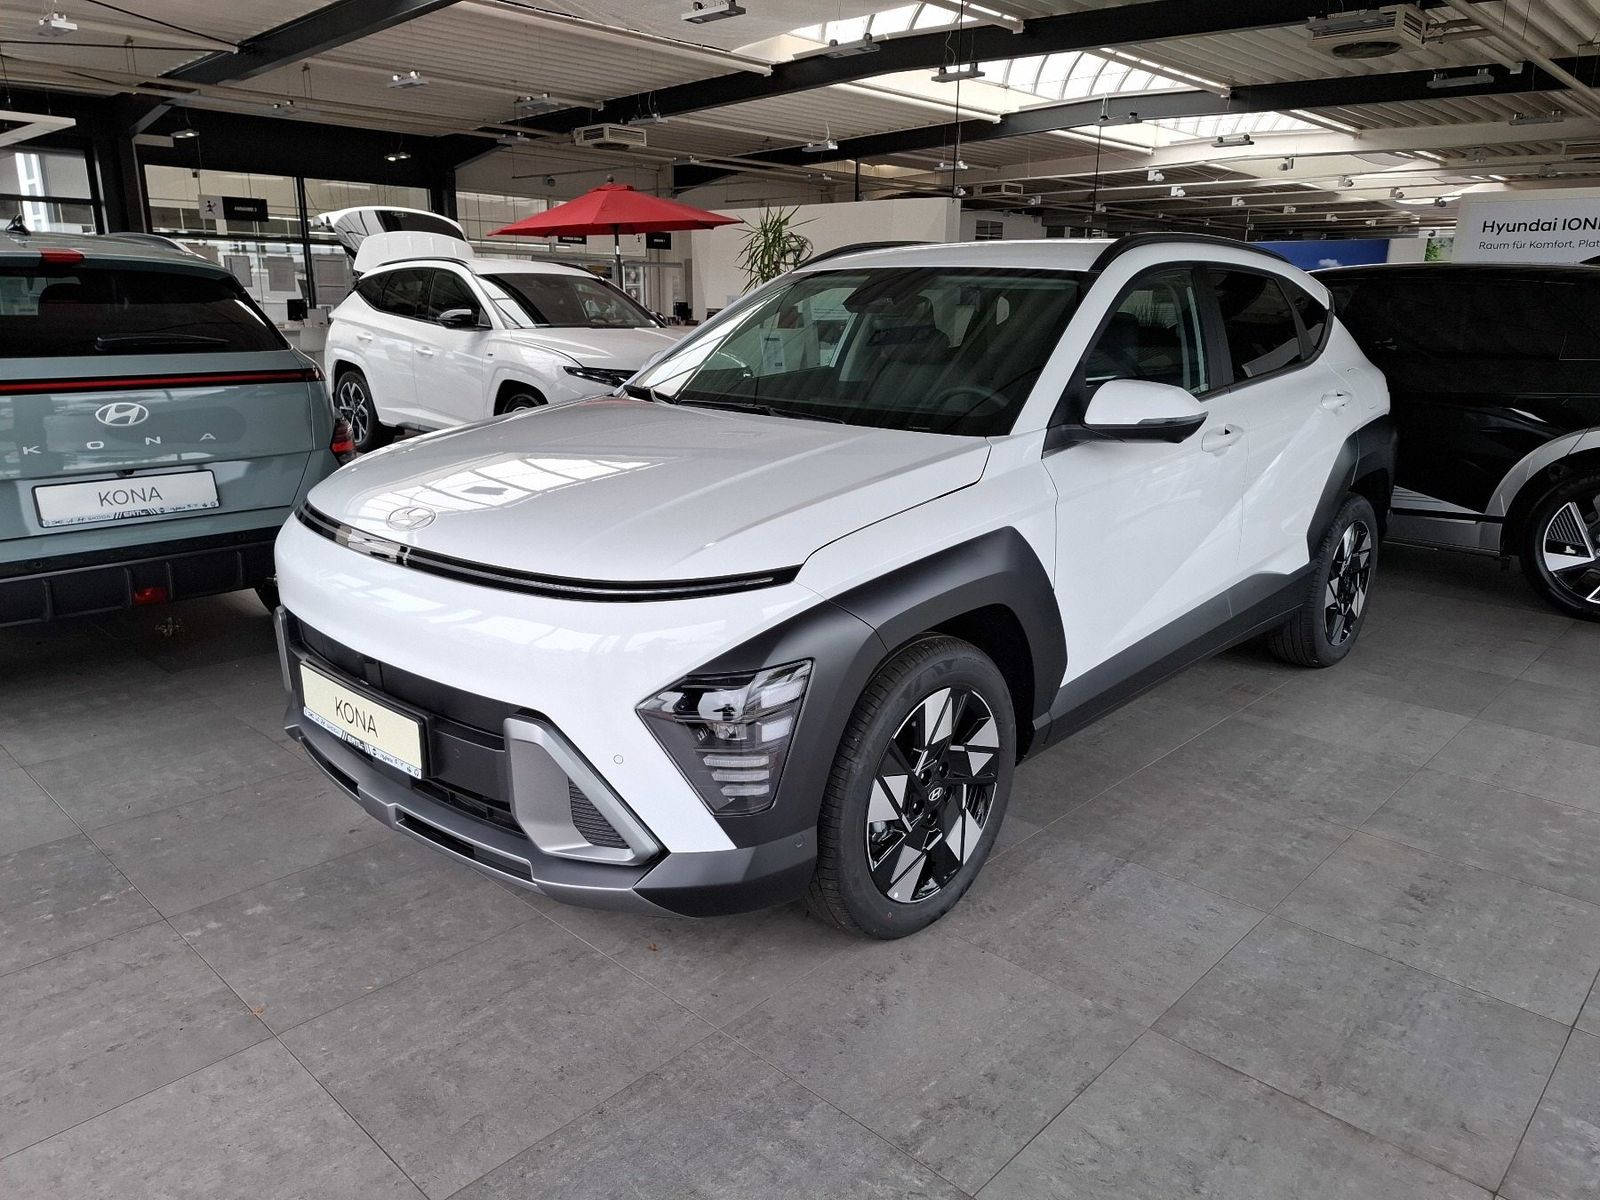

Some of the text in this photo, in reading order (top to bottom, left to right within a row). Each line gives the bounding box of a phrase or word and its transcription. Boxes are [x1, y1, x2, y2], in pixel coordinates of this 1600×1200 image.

[1482, 217, 1558, 236] Hyundai
[1478, 241, 1510, 250] Raum
[1512, 240, 1527, 249] für
[1529, 240, 1575, 249] Komfort,
[22, 432, 216, 456] KONA
[98, 486, 163, 508] KONA
[334, 696, 378, 738] KONA
